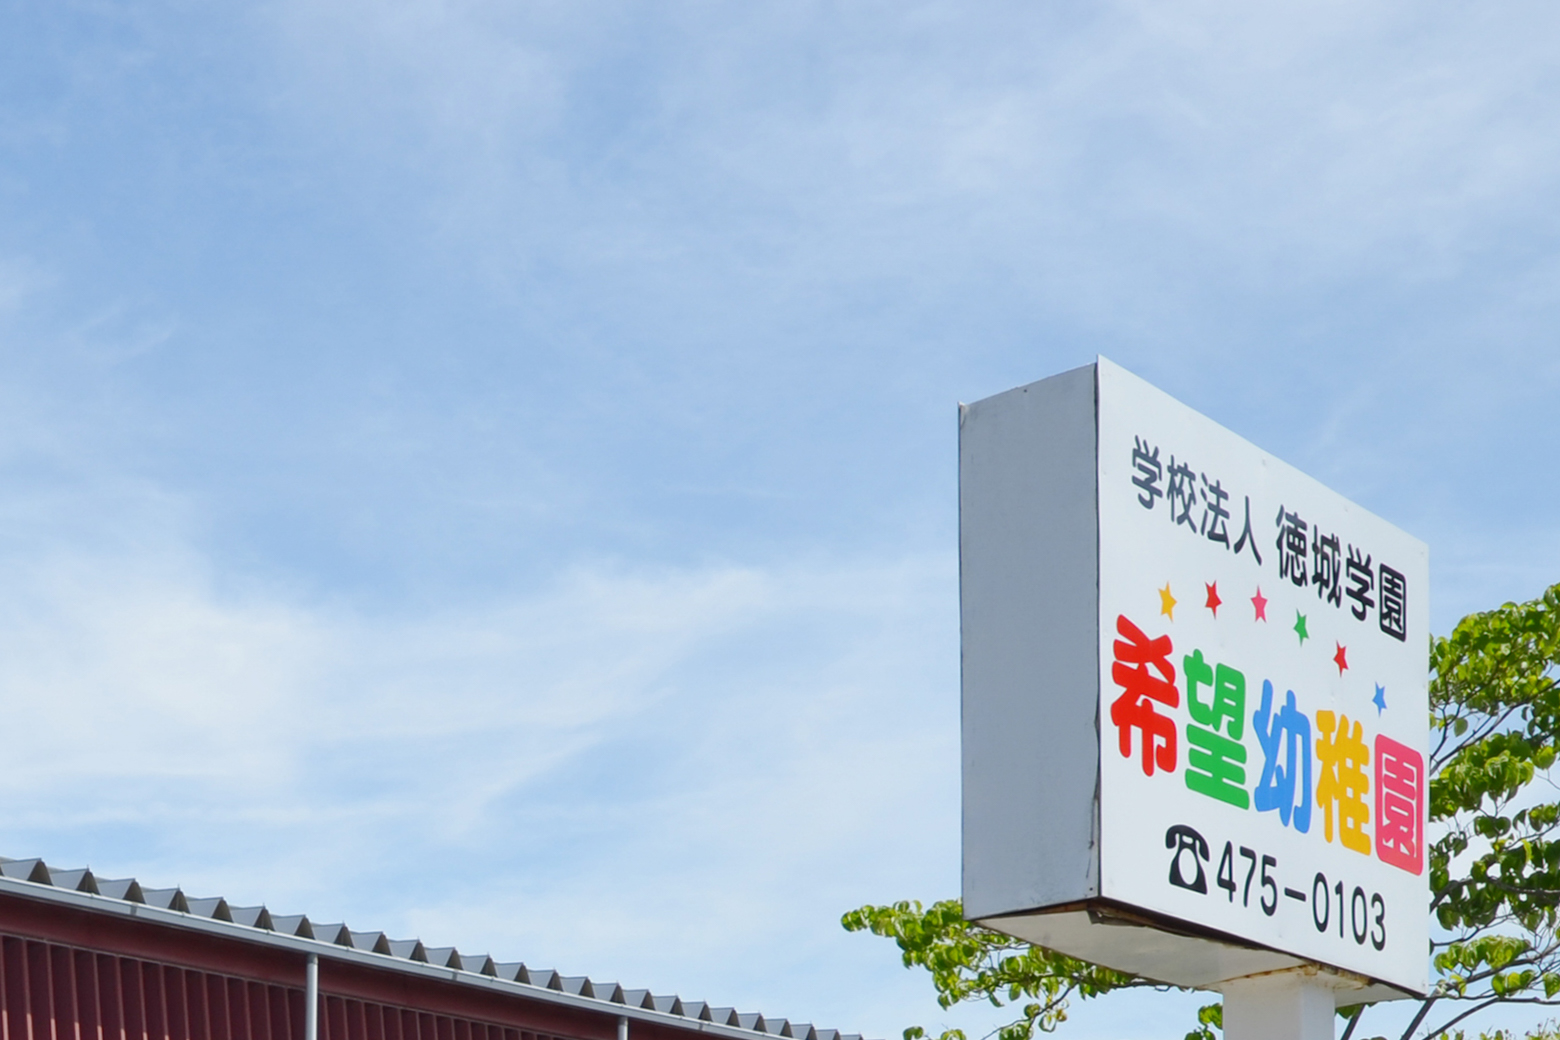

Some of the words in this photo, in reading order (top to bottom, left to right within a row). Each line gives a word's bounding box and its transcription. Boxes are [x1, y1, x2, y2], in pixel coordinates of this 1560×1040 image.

[1131, 434, 1262, 566] 学校法人
[1275, 504, 1407, 643] 徳城学園
[1110, 613, 1424, 877] 希望幼稚園
[1216, 840, 1386, 952] 475-0103
